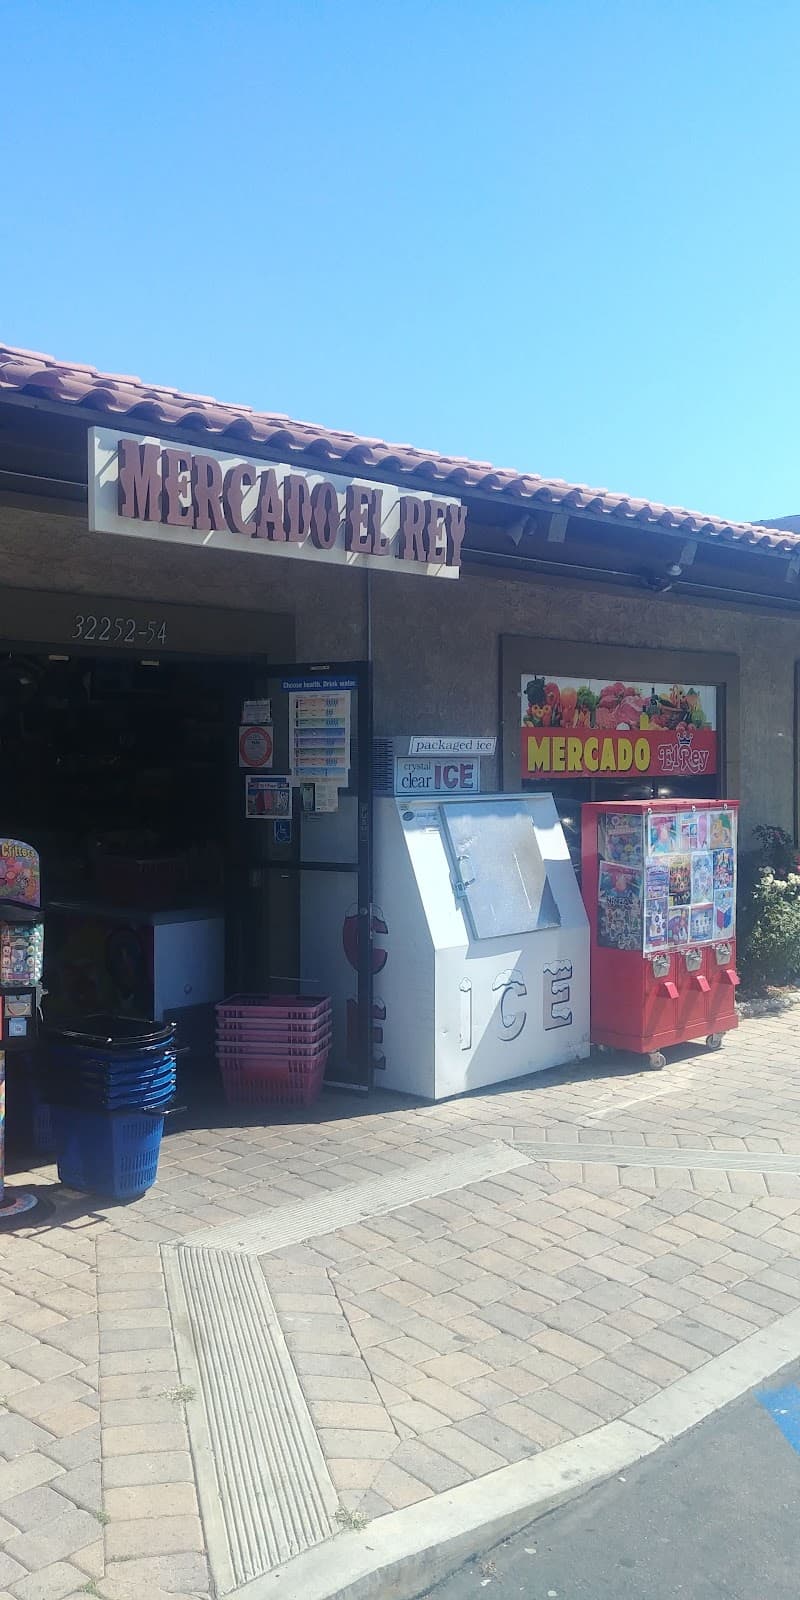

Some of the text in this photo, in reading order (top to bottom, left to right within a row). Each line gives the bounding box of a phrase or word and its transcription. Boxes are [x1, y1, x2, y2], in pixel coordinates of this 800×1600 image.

[117, 439, 468, 566] MERCADO EL REY
[71, 615, 168, 645] 32252-54
[282, 680, 303, 688] Choose
[323, 680, 338, 688] Drink
[415, 739, 492, 753] packaged ice
[527, 735, 652, 774] MERCADO
[401, 761, 474, 790] clear ICE
[403, 761, 432, 773] crystal
[458, 959, 573, 1051] ICE
